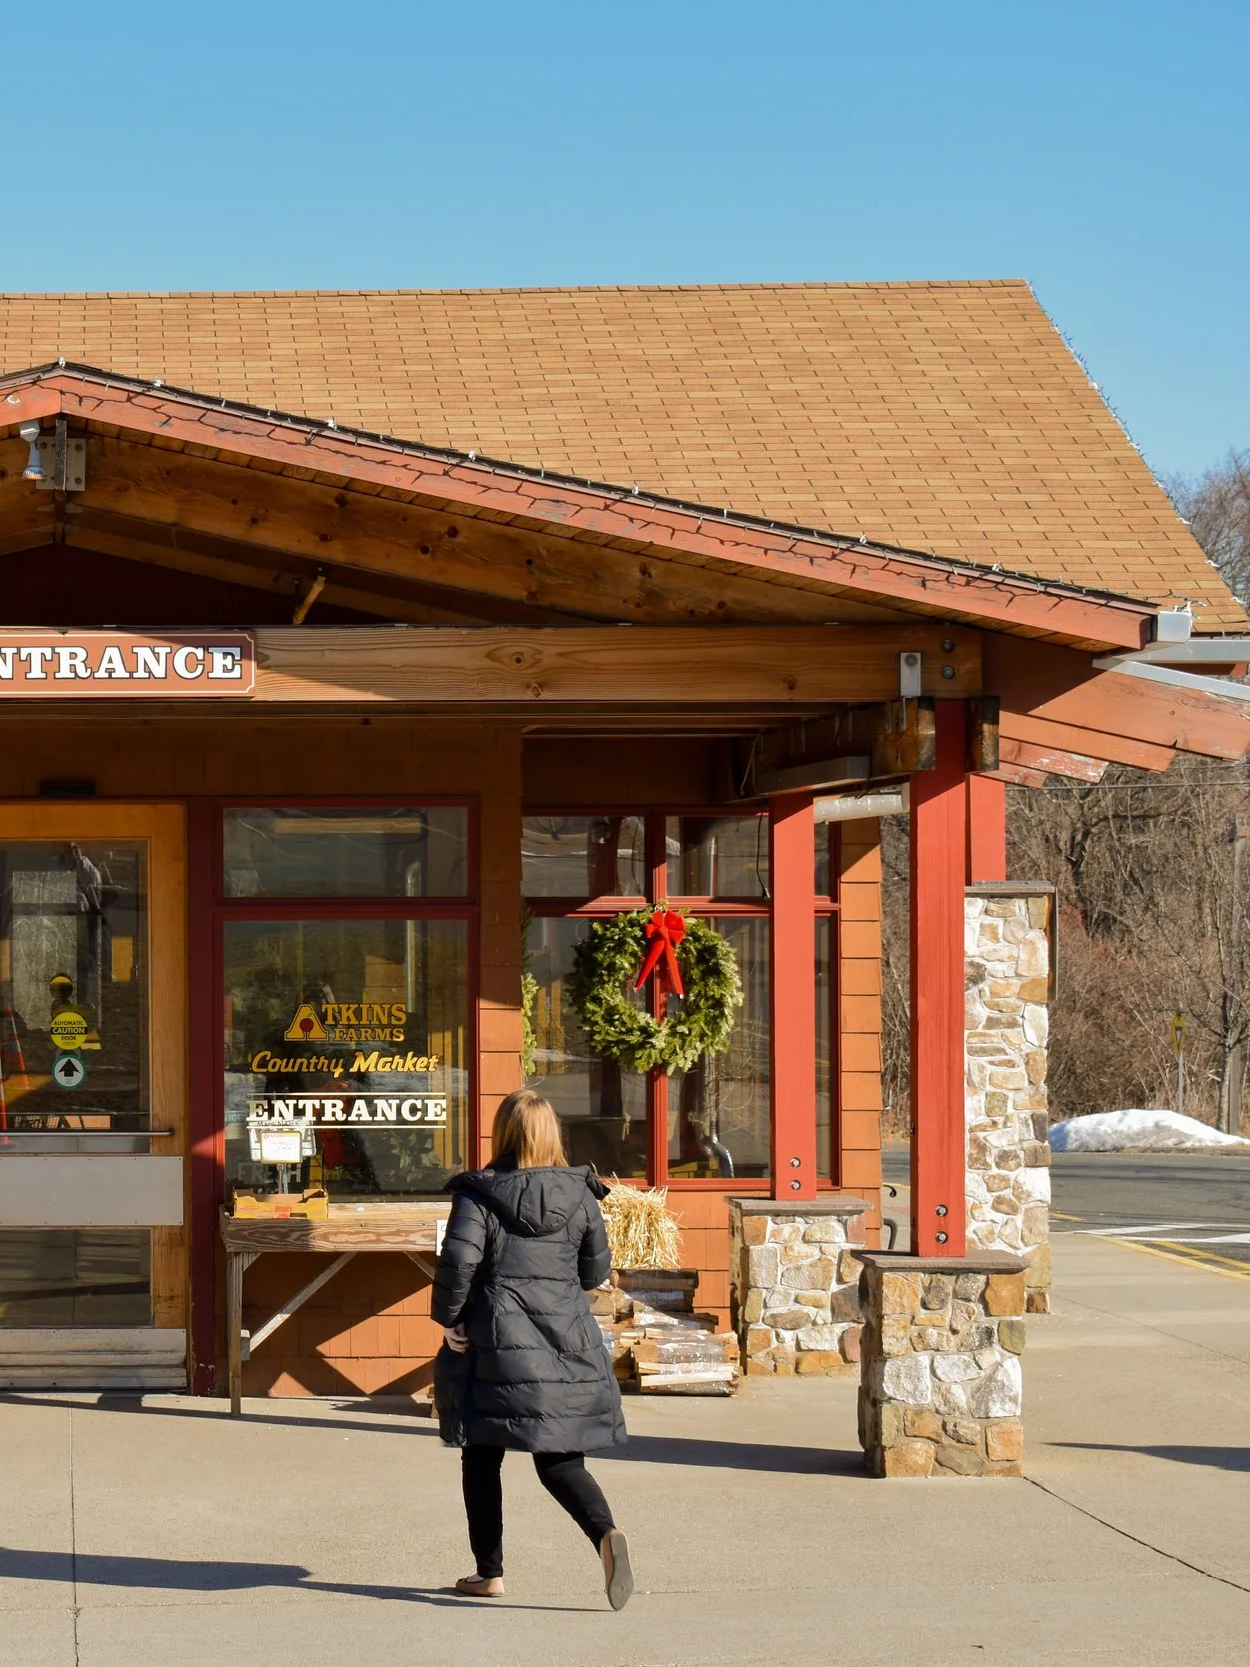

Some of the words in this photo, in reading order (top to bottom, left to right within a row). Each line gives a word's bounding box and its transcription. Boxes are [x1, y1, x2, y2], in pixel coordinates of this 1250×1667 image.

[334, 1028, 405, 1041] FARMS
[252, 1051, 343, 1078] Country
[349, 1051, 438, 1072] Market
[246, 1099, 447, 1121] ENTRANCE
[237, 1162, 301, 1184] FREH
